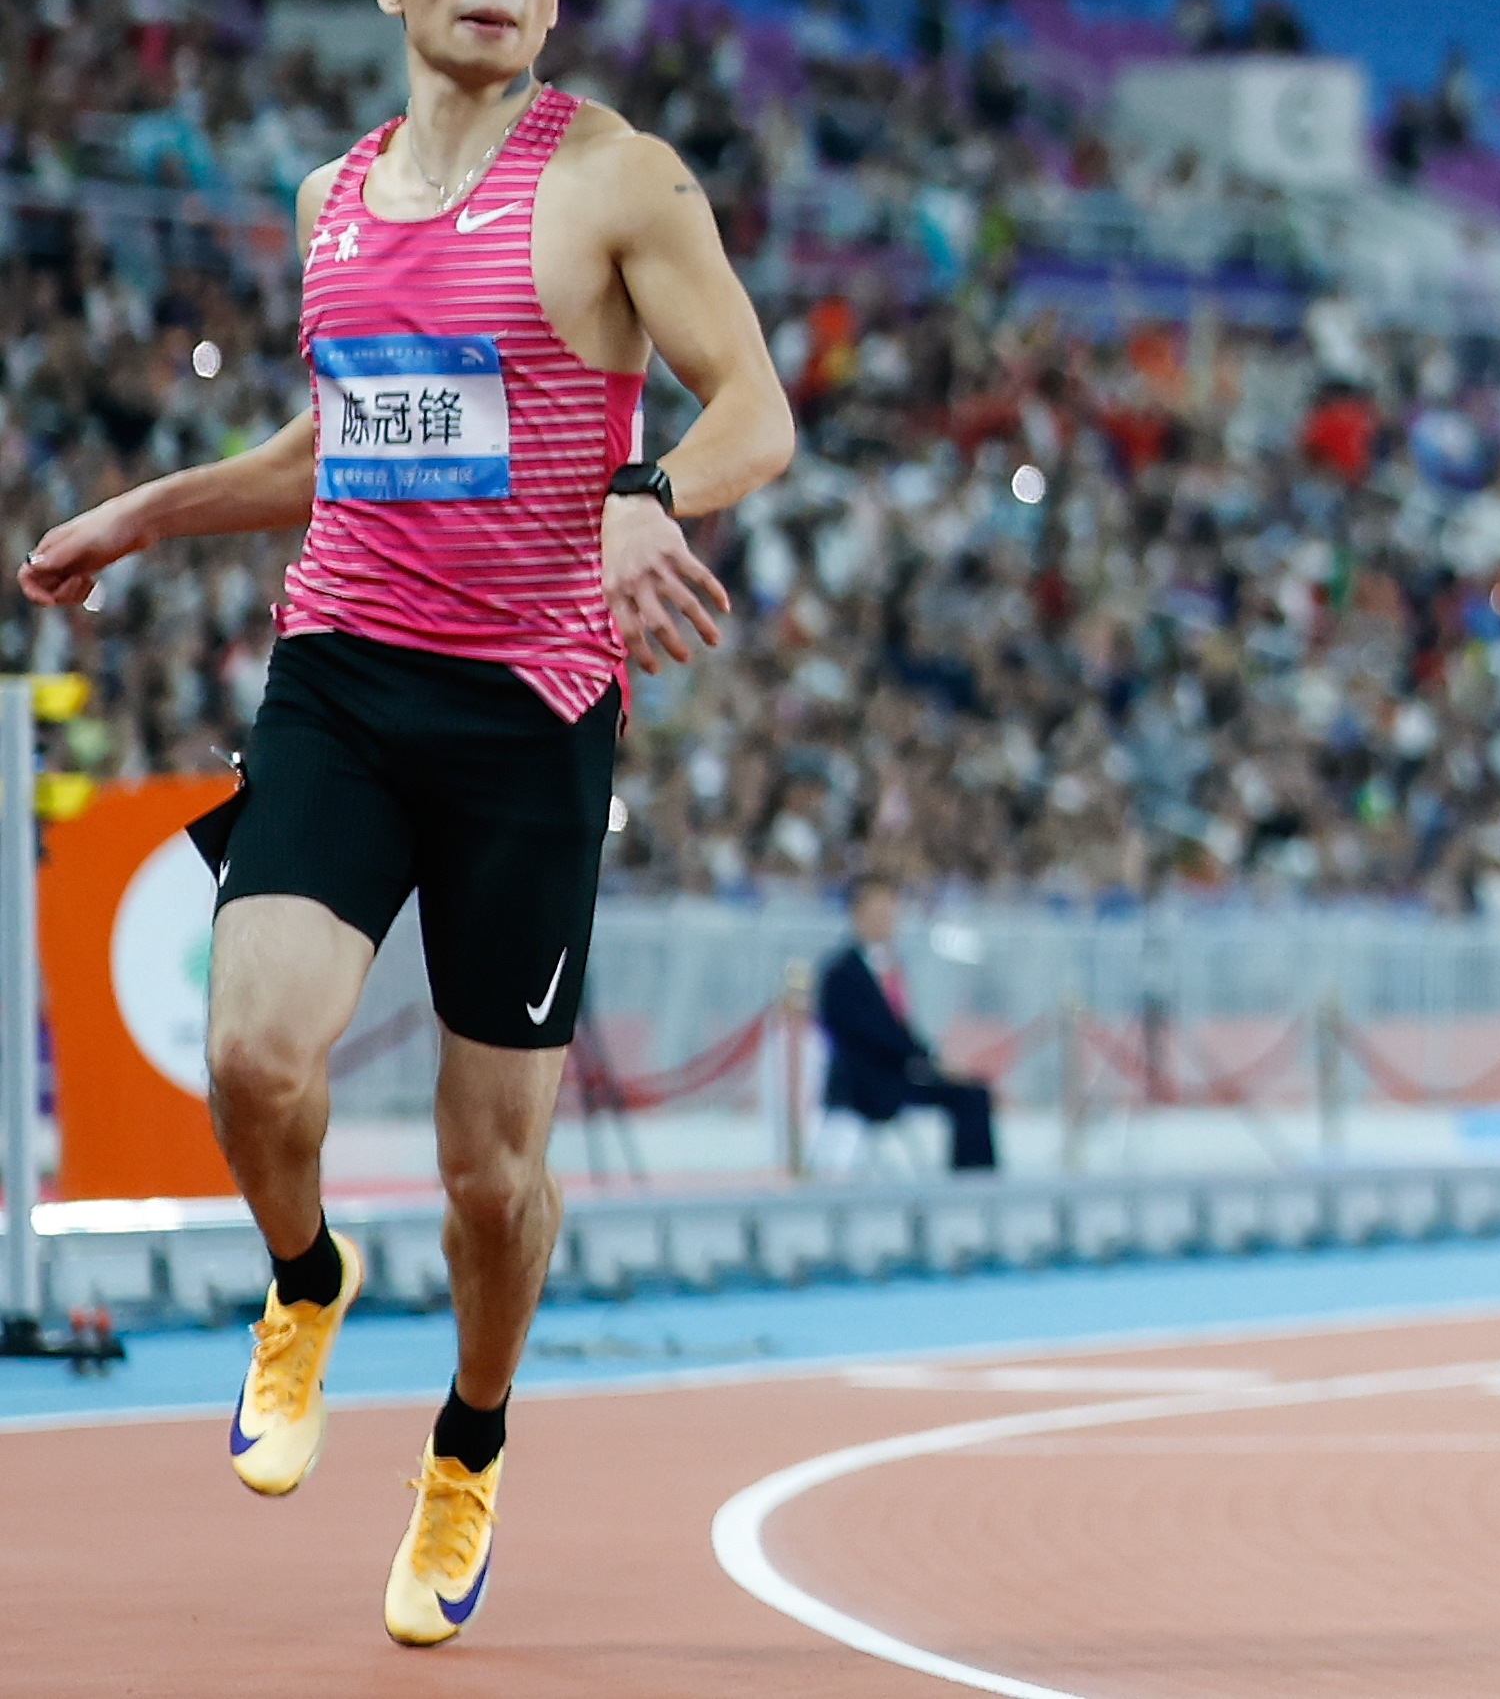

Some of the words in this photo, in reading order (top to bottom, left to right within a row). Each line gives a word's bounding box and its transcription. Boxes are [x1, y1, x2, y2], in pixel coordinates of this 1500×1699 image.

[305, 221, 359, 274] 广东
[341, 387, 463, 446] 陈冠锋
